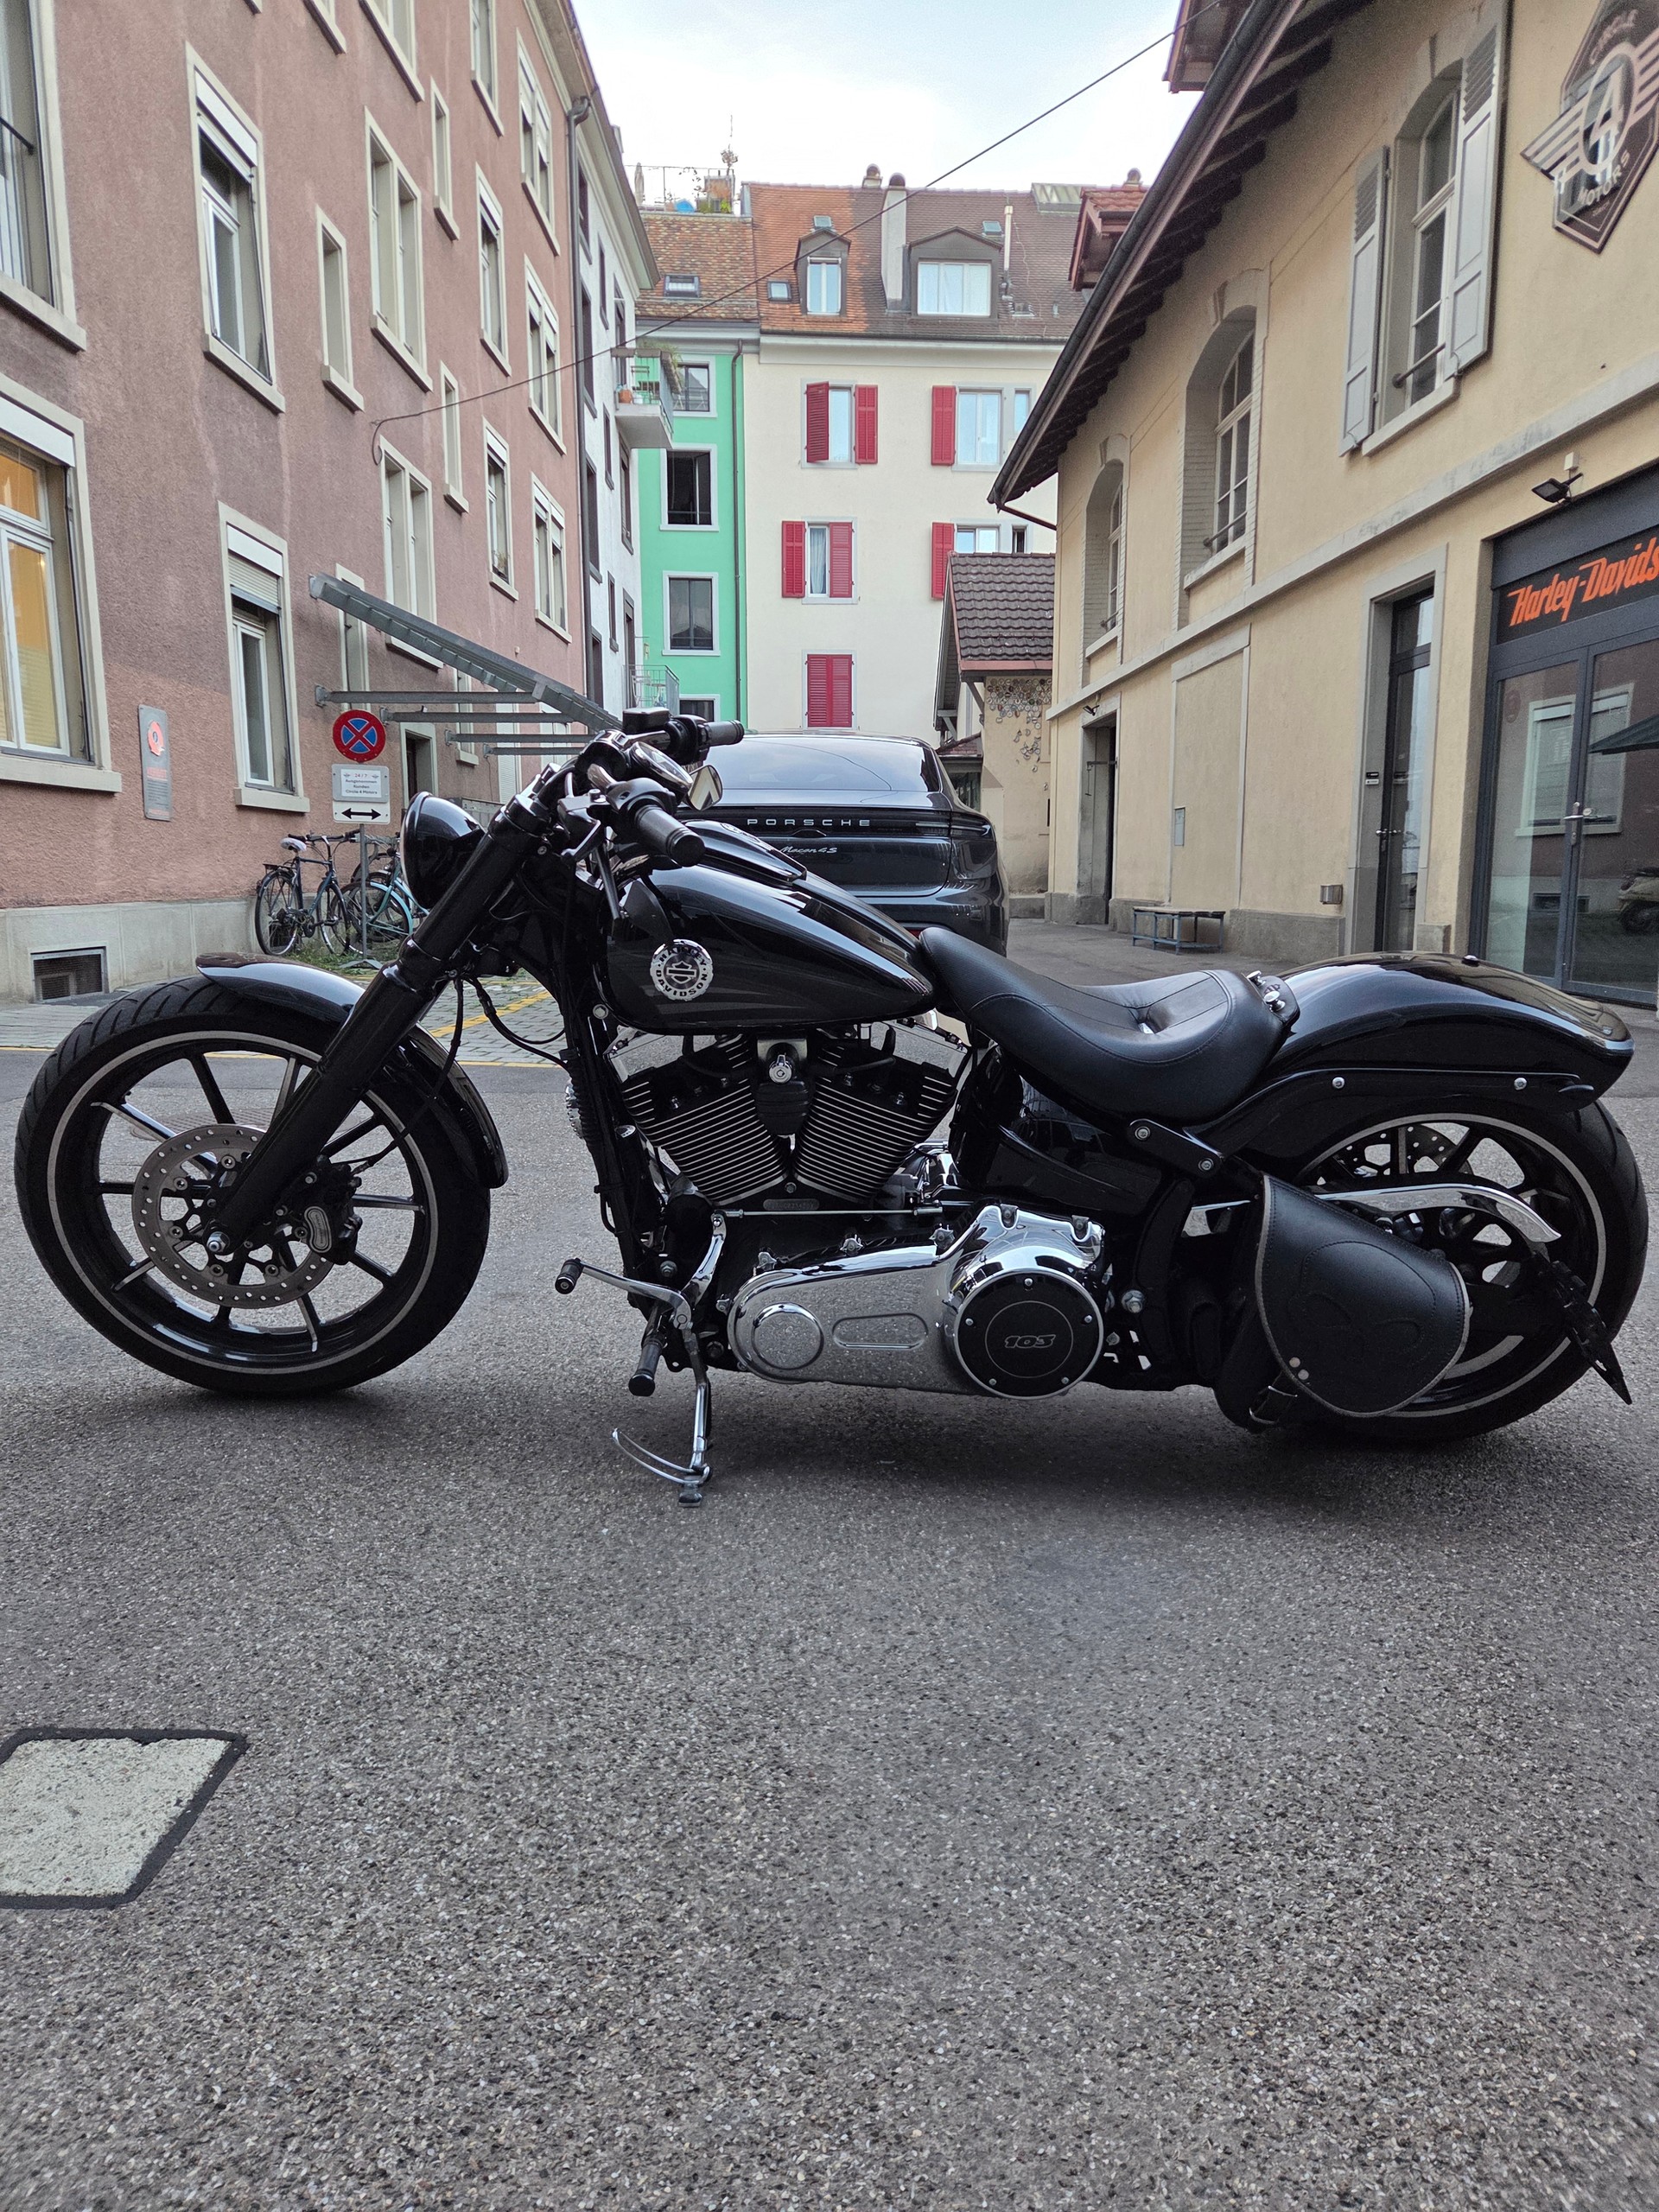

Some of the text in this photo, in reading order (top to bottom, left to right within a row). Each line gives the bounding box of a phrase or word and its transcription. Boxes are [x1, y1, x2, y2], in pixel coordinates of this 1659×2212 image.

[1590, 64, 1624, 149] 4
[1577, 149, 1630, 207] MOTORS
[747, 818, 870, 827] PORSCHE
[655, 969, 709, 997] DAVIDSON
[1004, 1334, 1056, 1349] 103
